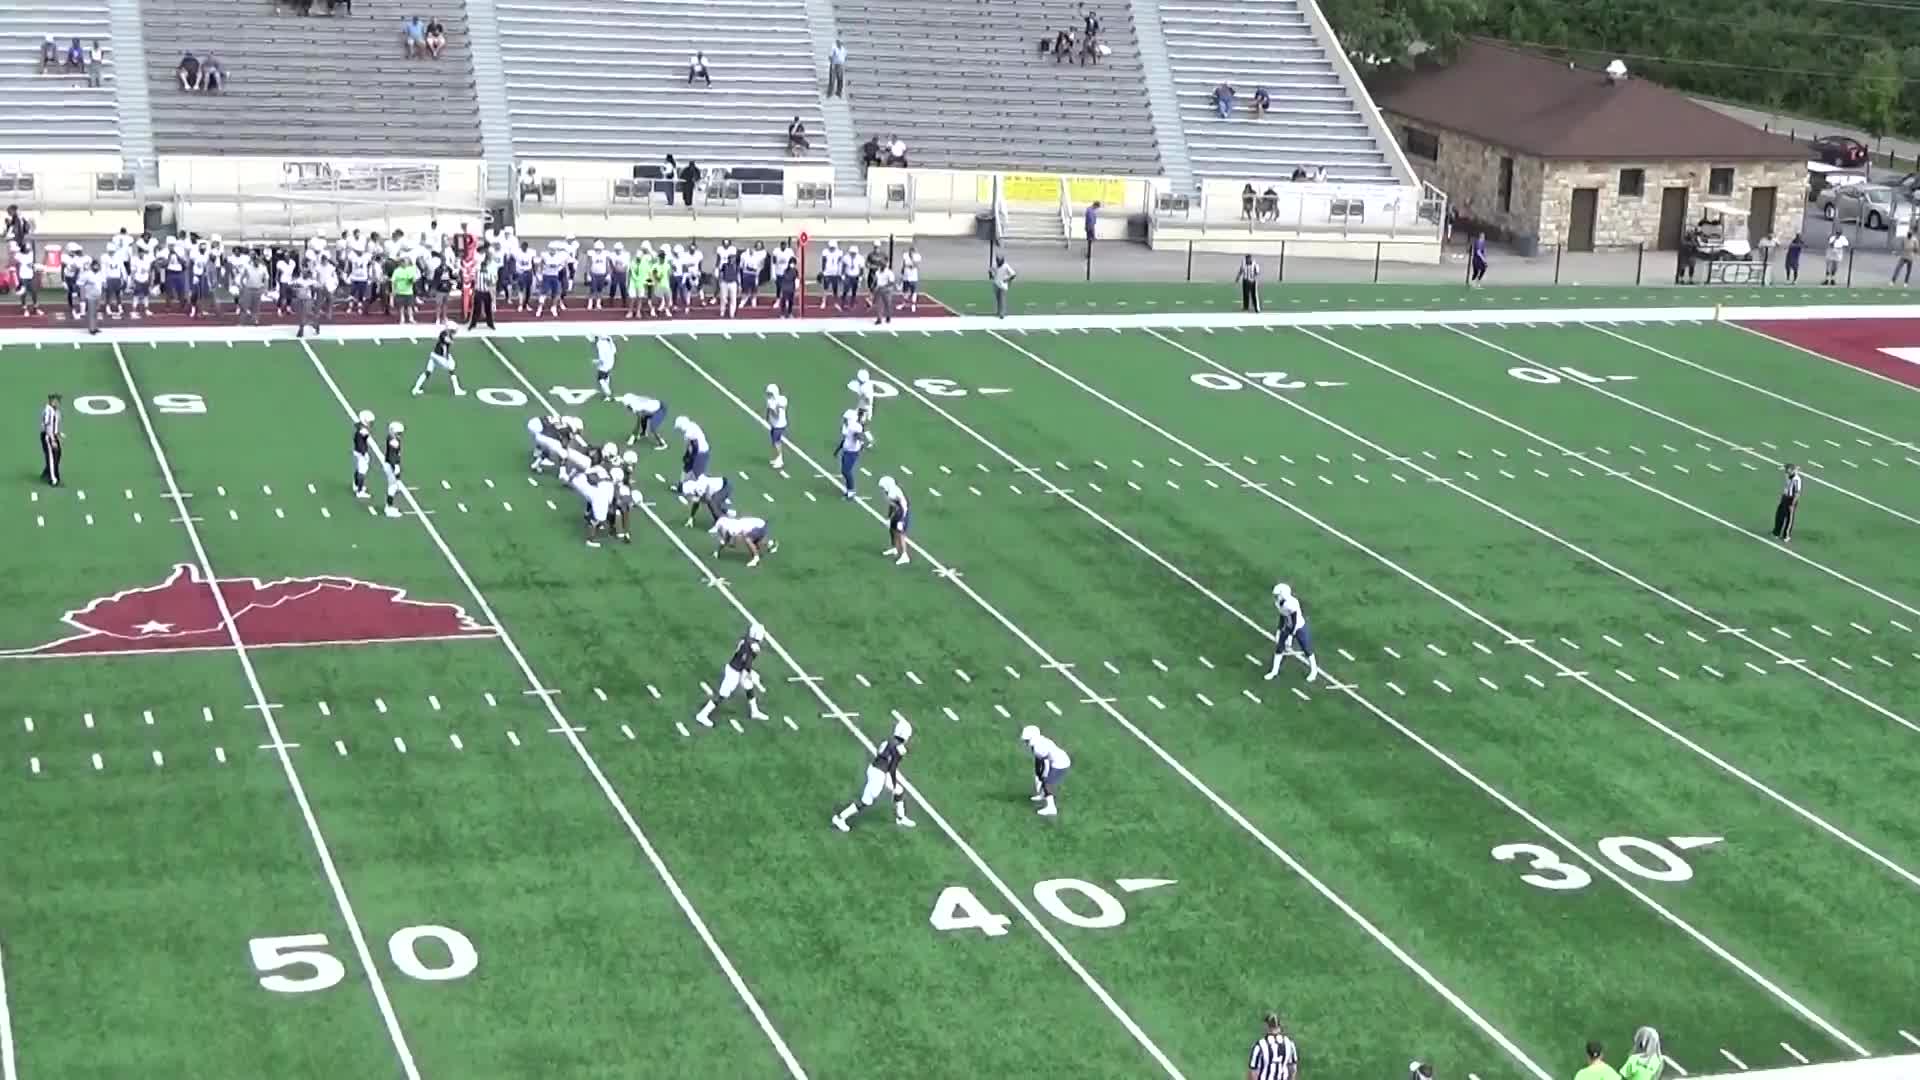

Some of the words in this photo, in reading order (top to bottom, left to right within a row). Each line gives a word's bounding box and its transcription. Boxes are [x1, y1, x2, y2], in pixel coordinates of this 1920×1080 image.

[476, 386, 600, 406] 40
[1190, 372, 1306, 390] 20
[73, 394, 207, 415] 50
[1491, 836, 1693, 889] 30
[929, 878, 1126, 936] 40
[249, 925, 478, 992] 50
